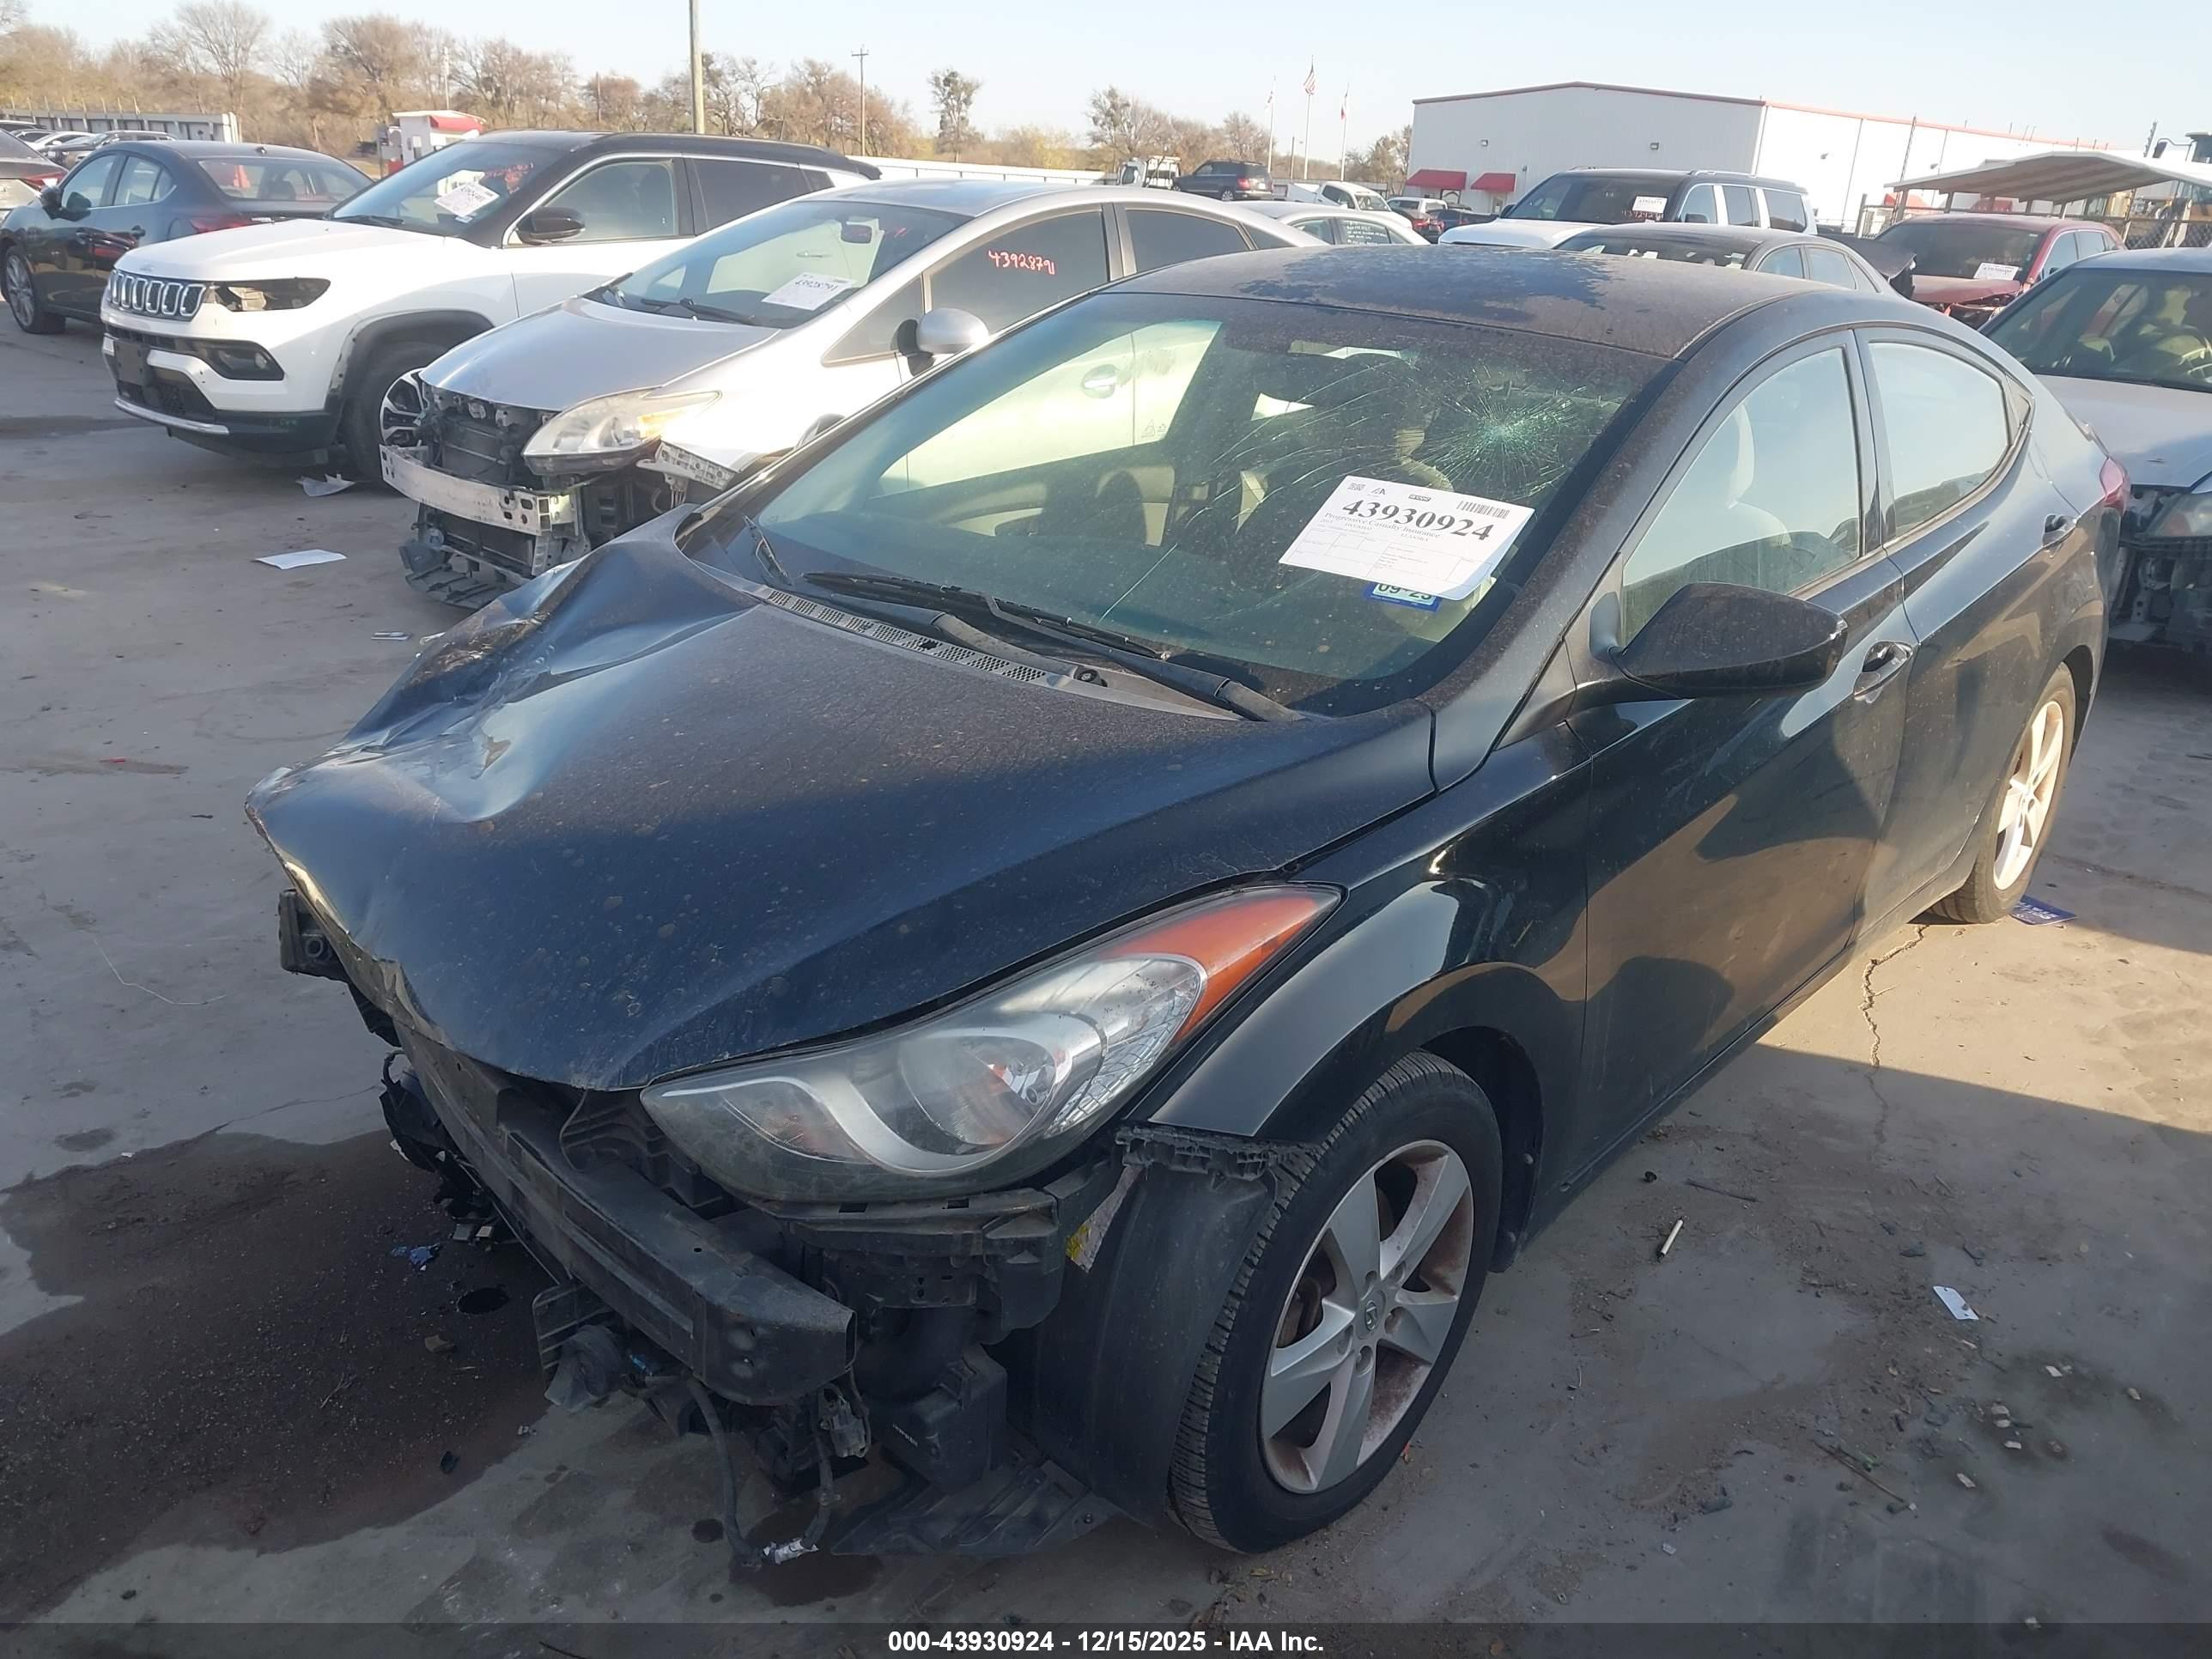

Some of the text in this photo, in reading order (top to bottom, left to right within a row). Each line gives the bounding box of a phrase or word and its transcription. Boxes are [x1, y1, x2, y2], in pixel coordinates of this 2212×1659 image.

[988, 250, 1055, 276] 43928791
[1324, 512, 1368, 526] Progressive
[1368, 518, 1402, 532] Casualty
[1402, 526, 1441, 538] Insurance
[1341, 499, 1495, 541] 43930924
